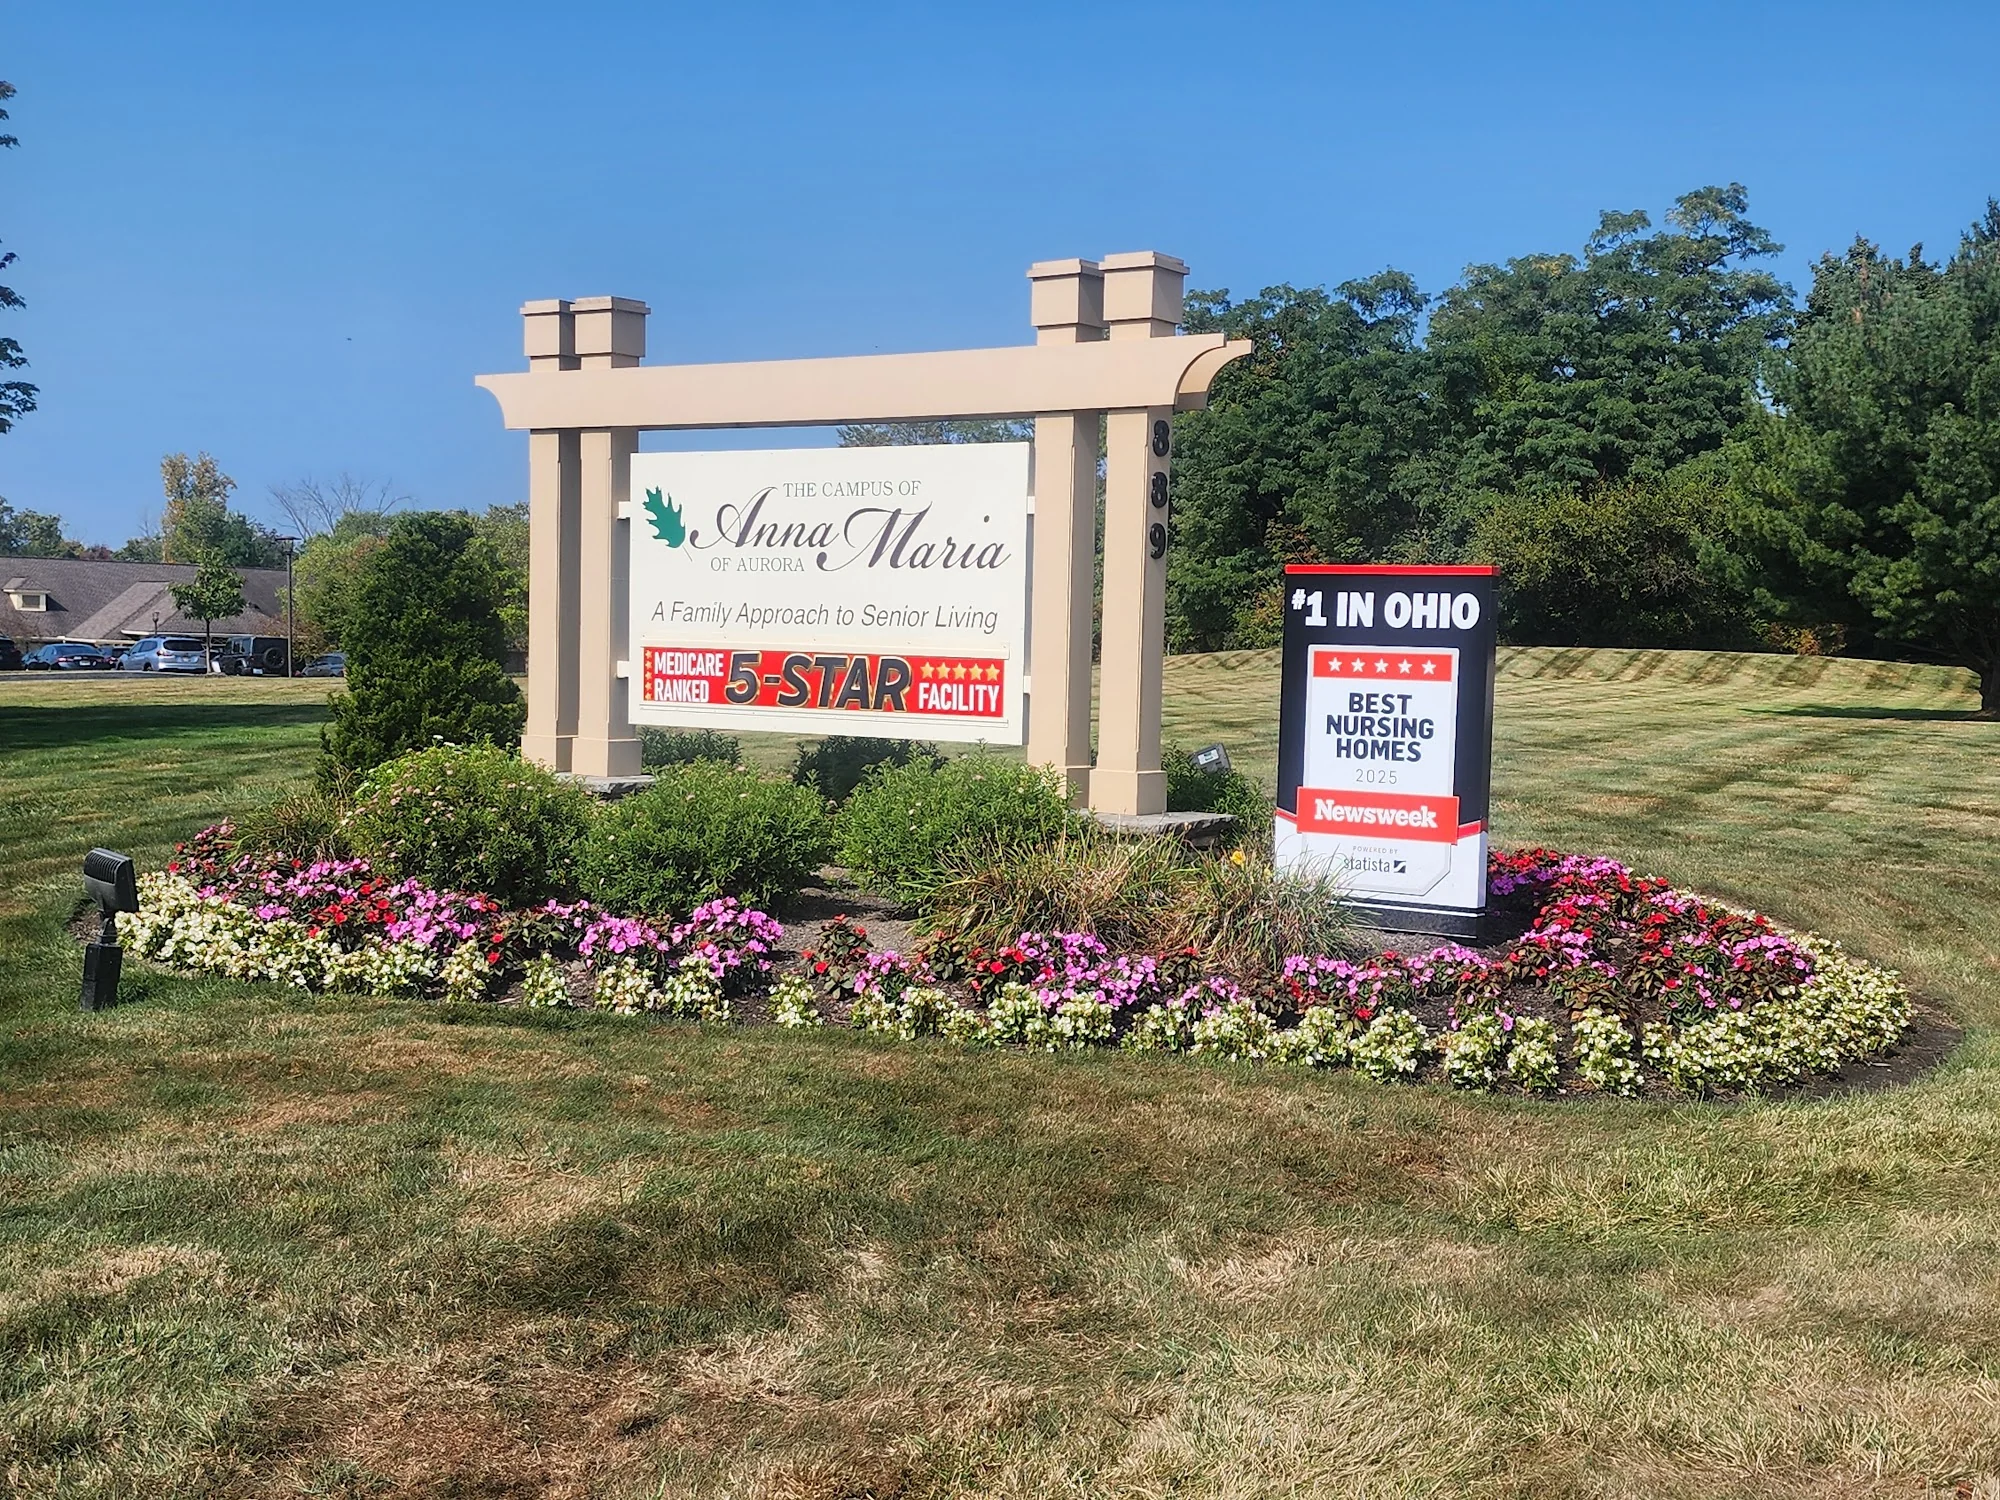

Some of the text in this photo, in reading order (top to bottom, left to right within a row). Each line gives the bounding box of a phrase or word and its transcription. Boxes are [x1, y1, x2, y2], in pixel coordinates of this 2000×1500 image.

[783, 480, 922, 498] THE CAMPUS OF
[1150, 419, 1170, 560] 889
[690, 486, 1012, 572] Anna Maria
[710, 557, 805, 573] OF AURORA
[651, 601, 999, 635] A Family Approach to Senior Living
[1291, 588, 1481, 630] #1 IN OHIO
[654, 651, 725, 678] MEDICARE
[653, 678, 710, 704] RANKED
[725, 650, 913, 713] 5-STAR
[918, 682, 1000, 713] FACILITY
[1348, 692, 1413, 715] BEST
[1326, 714, 1435, 740] NURSING
[1336, 738, 1422, 763] HOMES
[1355, 768, 1398, 785] 2025
[1314, 798, 1439, 829] Newsweek
[1352, 845, 1388, 855] POWERED
[1343, 856, 1391, 873] statista
